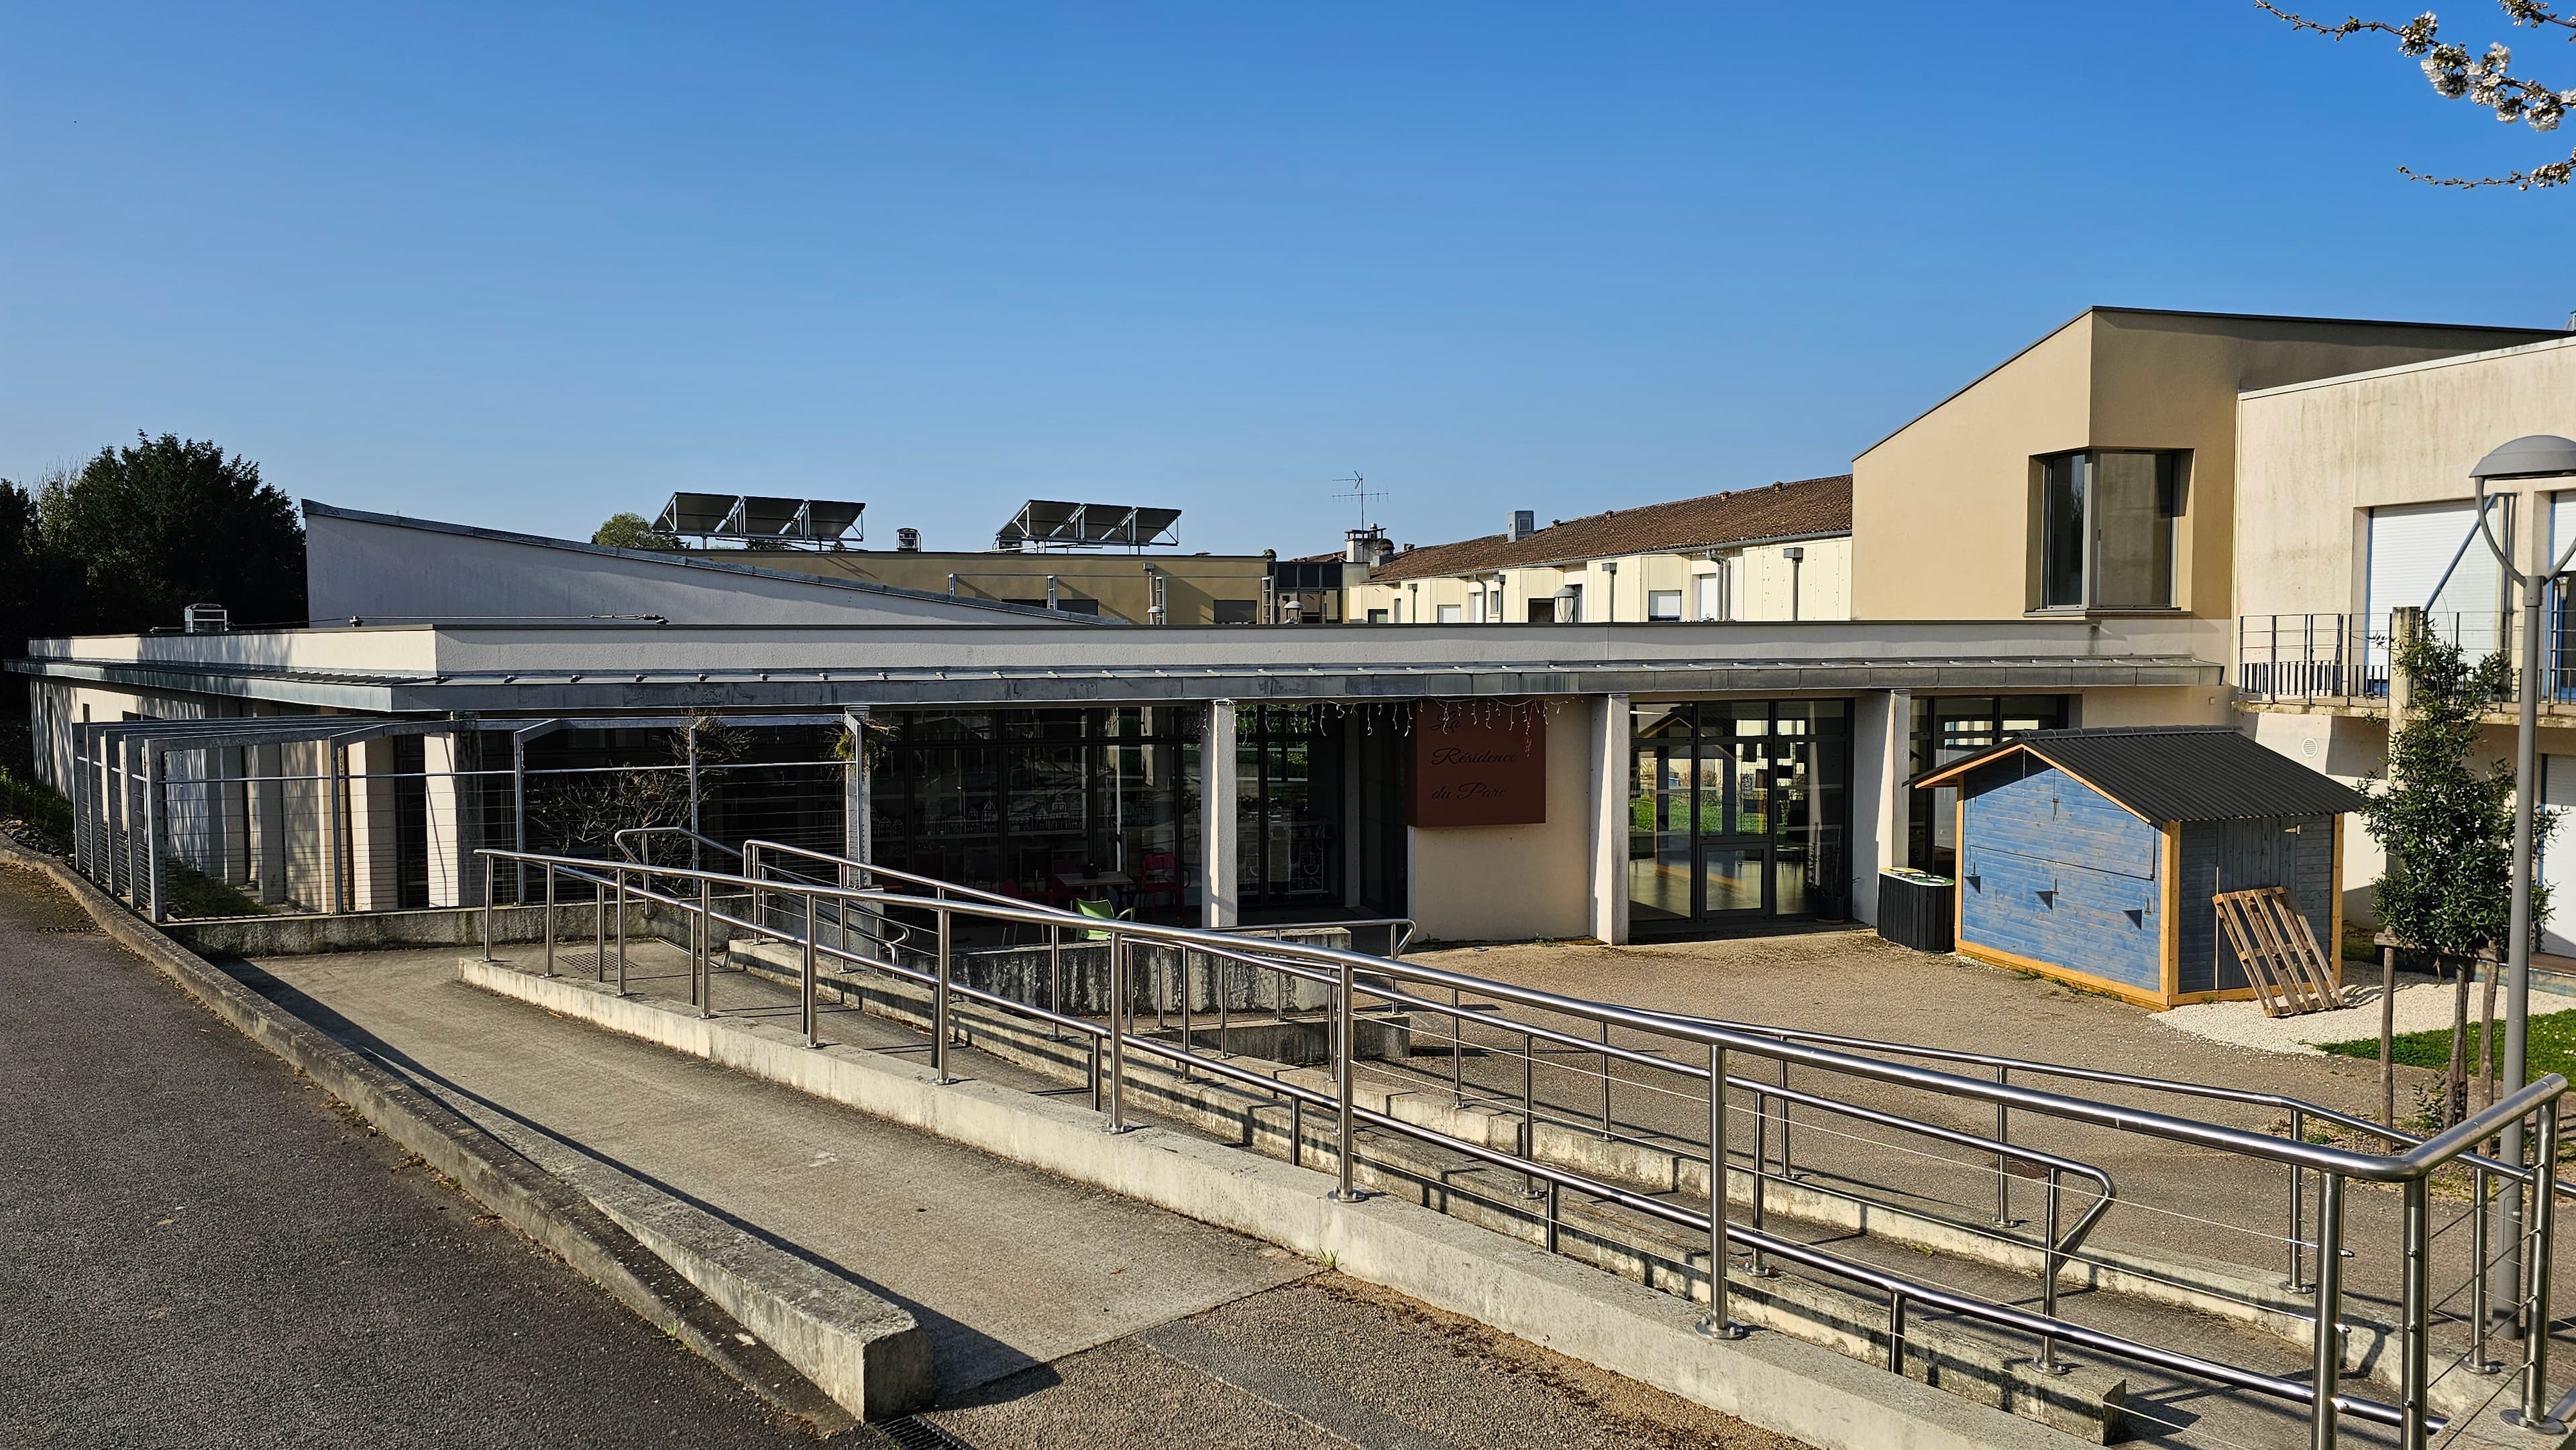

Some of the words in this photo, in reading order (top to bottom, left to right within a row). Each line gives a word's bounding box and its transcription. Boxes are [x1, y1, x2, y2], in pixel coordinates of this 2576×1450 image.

[1430, 710, 1461, 733] La
[1431, 747, 1516, 765] Résidence
[1432, 786, 1451, 800] du
[1456, 782, 1508, 800] Parc
